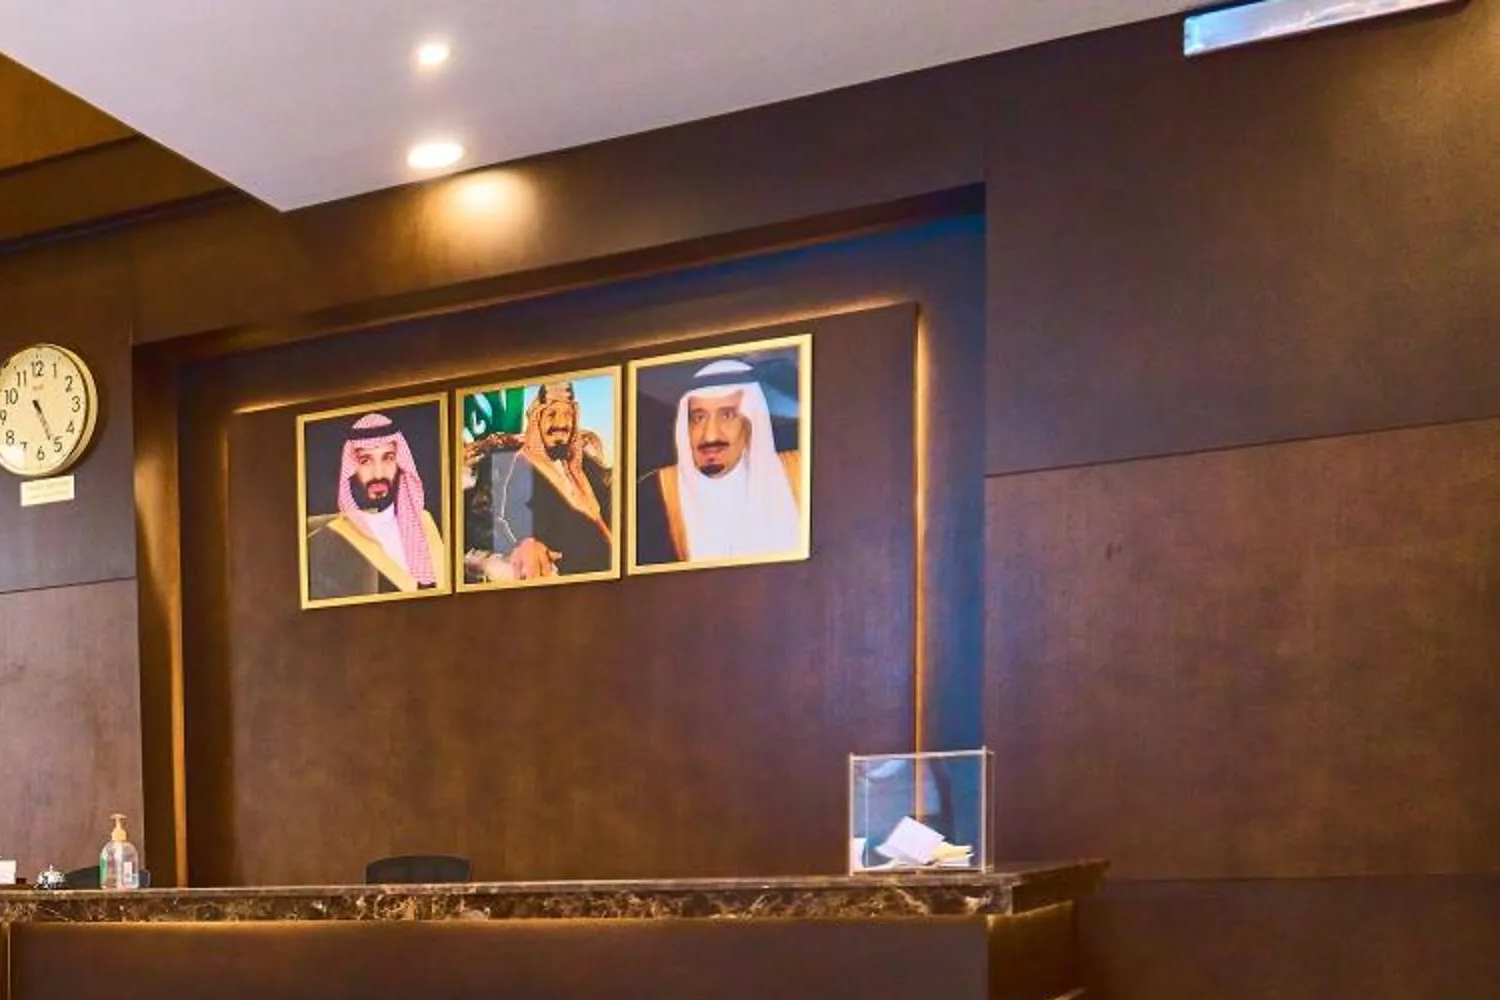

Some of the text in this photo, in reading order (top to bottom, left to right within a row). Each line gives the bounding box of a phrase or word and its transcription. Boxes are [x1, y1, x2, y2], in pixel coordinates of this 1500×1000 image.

[30, 360, 44, 377] 12
[16, 370, 27, 387] 11
[65, 375, 73, 392] 2
[4, 388, 19, 405] 10
[72, 395, 81, 413] 3
[0, 409, 7, 426] 9
[66, 421, 75, 435] 4
[5, 430, 15, 445] 8
[54, 436, 63, 453] 5
[36, 446, 45, 461] 6
